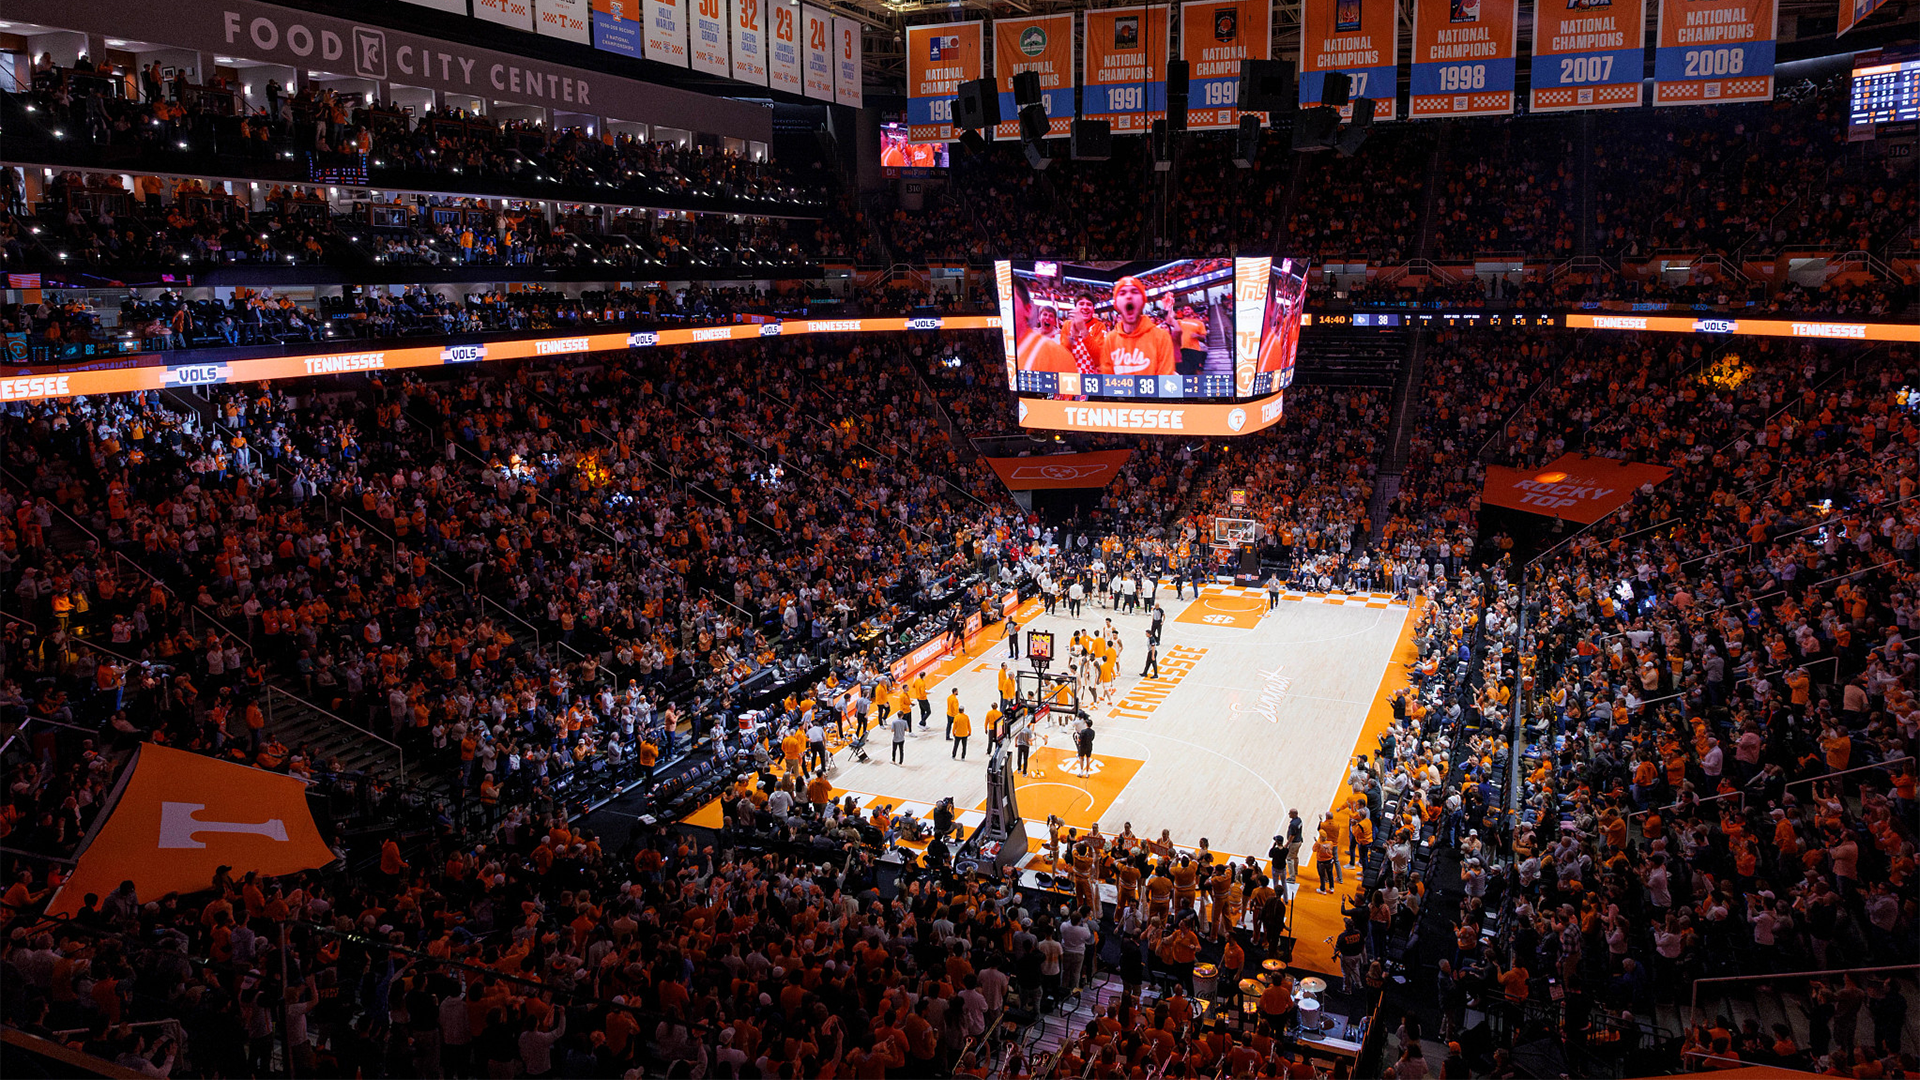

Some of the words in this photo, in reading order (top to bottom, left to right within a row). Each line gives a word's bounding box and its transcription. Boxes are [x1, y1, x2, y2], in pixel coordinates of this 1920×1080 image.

[559, 14, 568, 28] T
[740, 0, 758, 31] 32
[776, 6, 793, 42] 23
[1686, 8, 1746, 26] NATIONAL
[1560, 17, 1616, 34] NATIONAL
[1678, 23, 1754, 43] CHAMPIONS
[810, 18, 826, 52] 24
[1324, 36, 1372, 52] NATIONAL
[1438, 27, 1490, 44] NATIONAL
[1552, 32, 1624, 51] CHAMPIONS
[844, 30, 852, 60] 3
[1430, 42, 1496, 60] CHAMPIONS
[224, 12, 344, 61] FOOD
[396, 45, 476, 84] CITY
[490, 64, 591, 105] CENTER
[1317, 50, 1378, 68] CHAMPIONS
[1684, 48, 1744, 76] 2008
[926, 66, 964, 81] NATIONAL
[1098, 66, 1152, 82] CHAMPIONS
[1196, 61, 1240, 76] CHAMPIO
[1439, 64, 1486, 91] 1998
[1560, 56, 1614, 84] 2007
[920, 80, 969, 94] CHAMPIO
[1008, 74, 1059, 89] CIONS
[1108, 87, 1142, 110] 1991
[929, 100, 952, 121] 198
[1319, 316, 1345, 324] 14:40
[1378, 315, 1388, 324] 38
[1593, 317, 1646, 329] TENNESSEE
[1704, 322, 1728, 332] VOLS
[1791, 324, 1866, 338] TENNESSEE
[0, 376, 70, 400] ESSEE
[179, 368, 216, 382] VOLS
[304, 352, 384, 373] TENNESSEE
[452, 347, 477, 360] VOLS
[535, 338, 589, 354] TENNESSEE
[636, 334, 652, 344] VOLS
[692, 328, 732, 341] TENNESSEE
[764, 325, 778, 334] VOLS
[808, 320, 861, 331] TENNESSEE
[914, 319, 936, 328] VOLS
[1111, 348, 1146, 366] Vols
[1062, 376, 1077, 391] T
[1085, 378, 1098, 393] 53
[1105, 378, 1133, 387] 14:40
[1140, 379, 1154, 394] 38
[1194, 376, 1198, 384] 3
[1064, 407, 1184, 429] TENNESSEE
[1512, 479, 1614, 500] ROCKY
[1519, 492, 1578, 509] TOP
[1202, 614, 1236, 624] SEC
[912, 639, 941, 665] TENNESSEE
[1107, 644, 1210, 721] TENNESSEE
[158, 801, 289, 849] T
